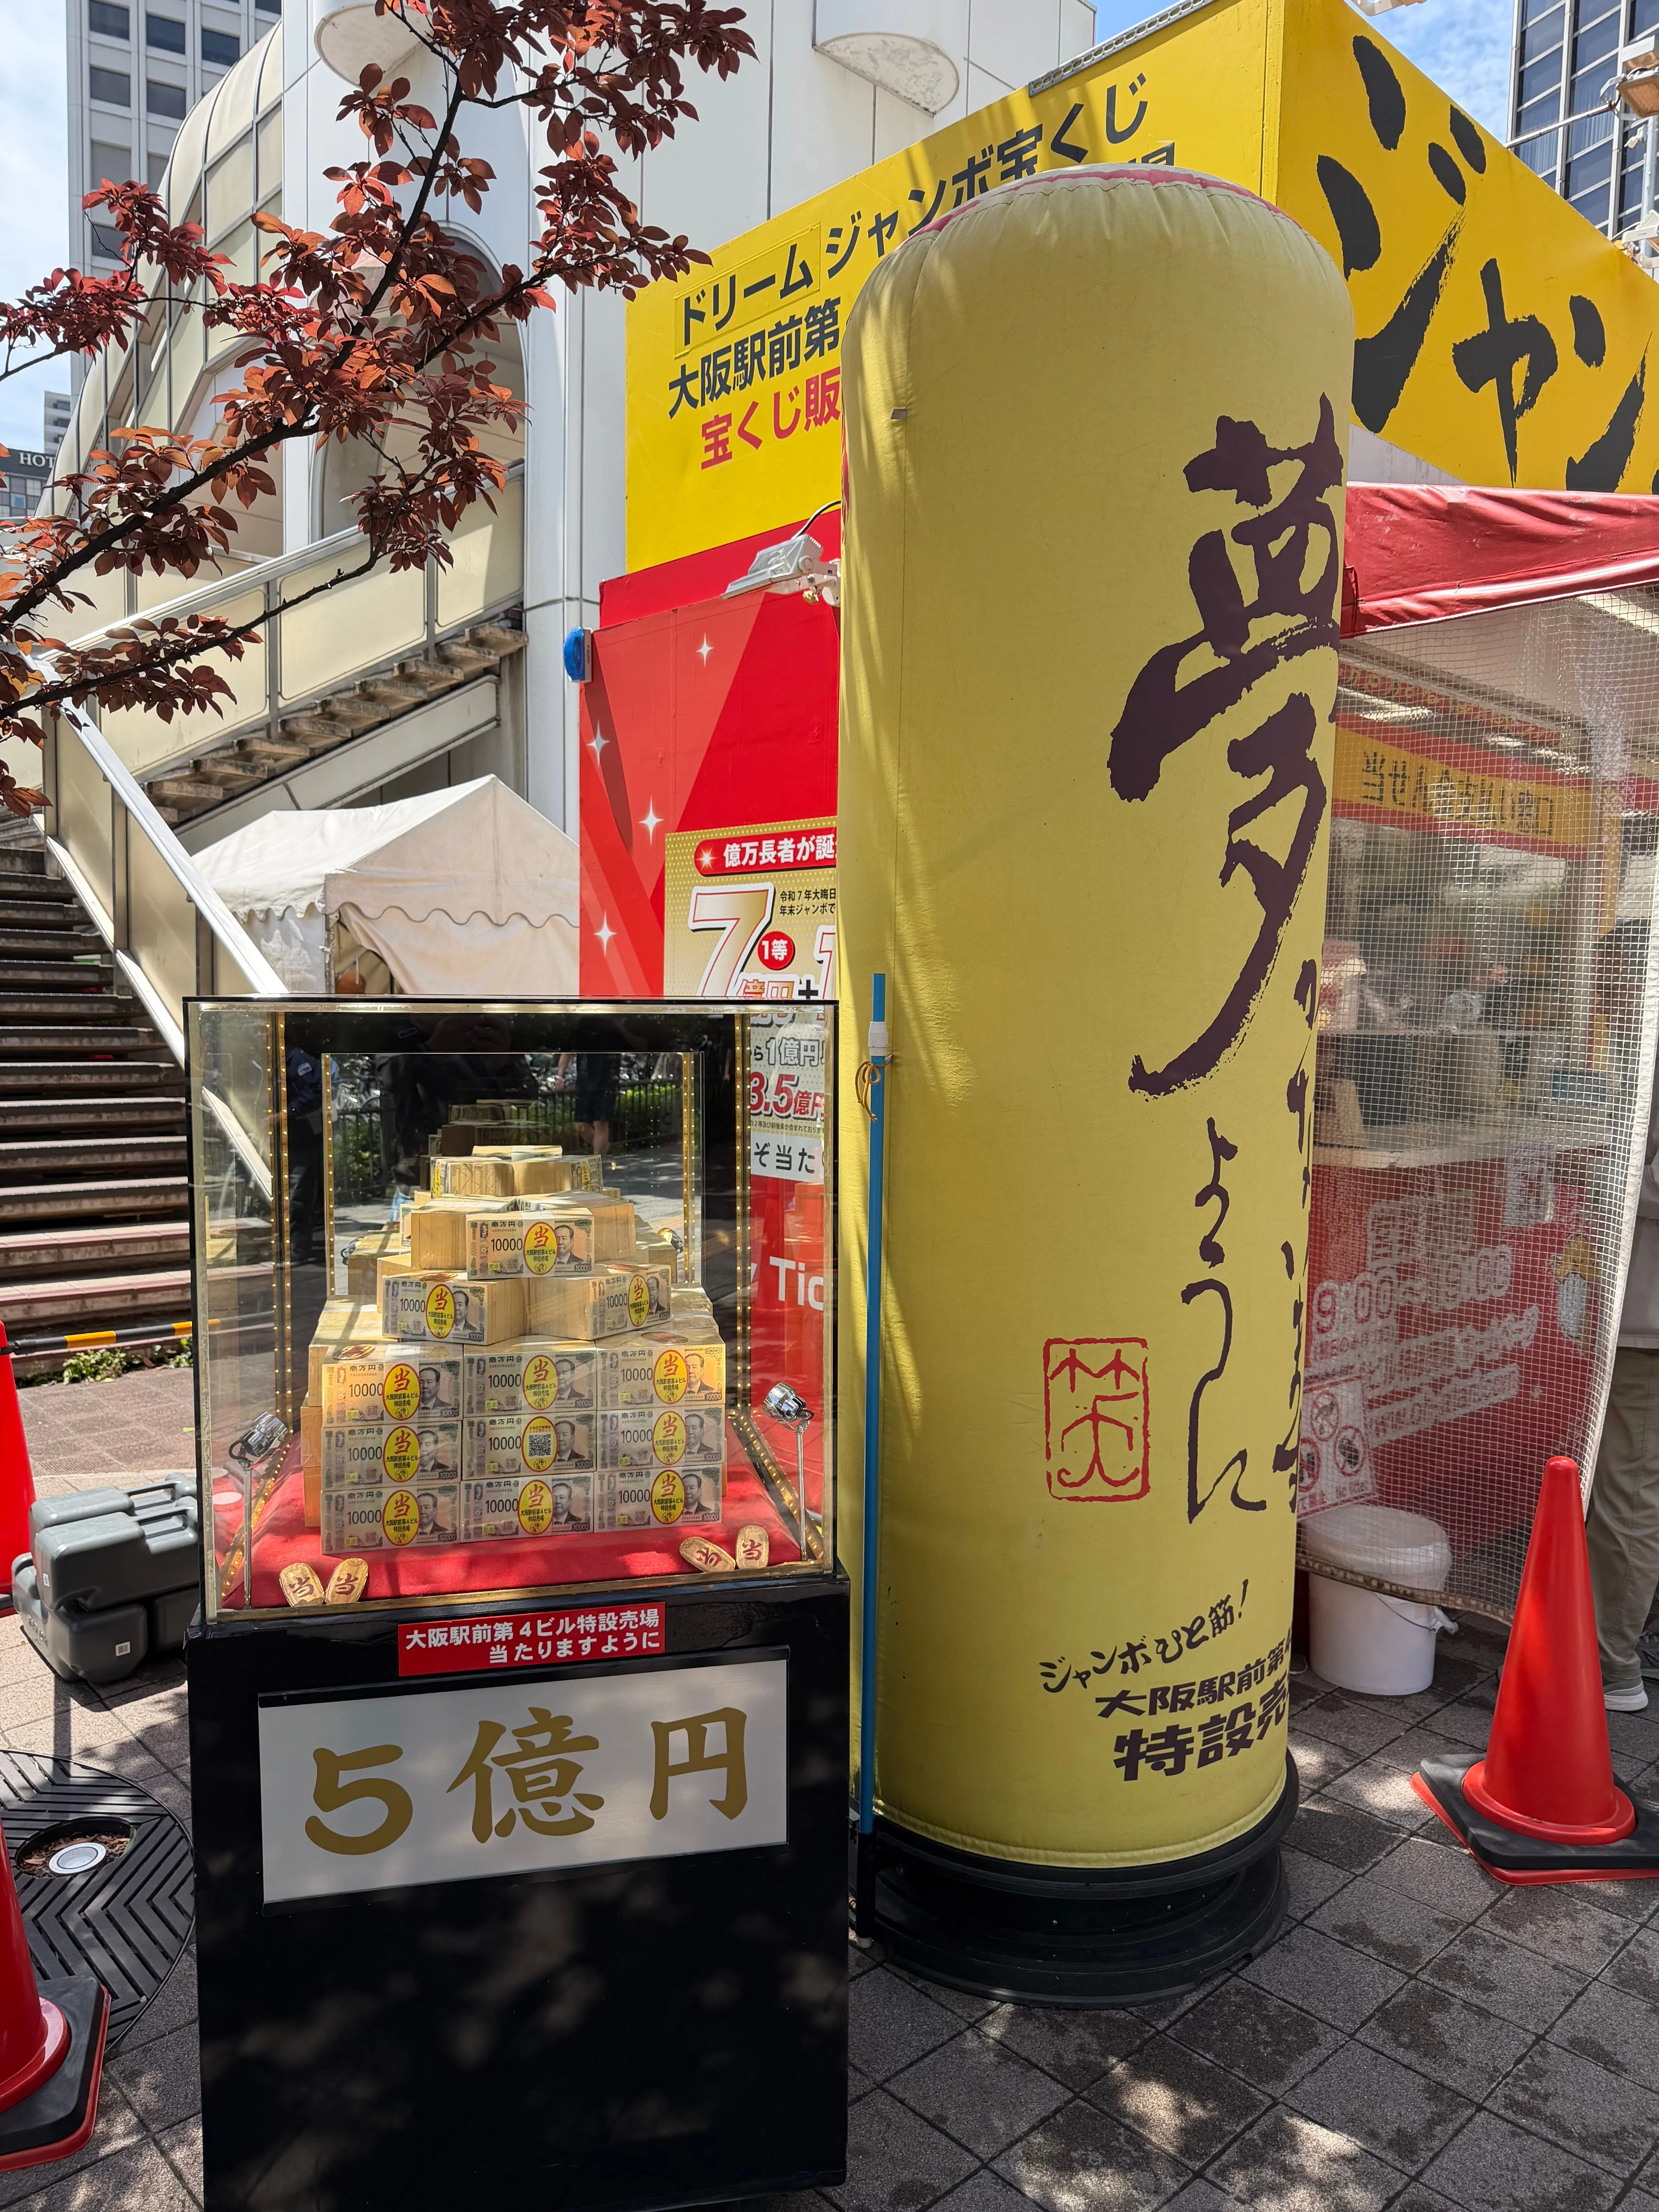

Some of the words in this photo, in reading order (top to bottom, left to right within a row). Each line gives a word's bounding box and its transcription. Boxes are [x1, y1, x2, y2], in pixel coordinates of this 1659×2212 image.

[1317, 35, 1659, 495] ジャン
[668, 296, 841, 419] 大阪駅前第
[701, 366, 841, 471] 宝くじ販
[723, 833, 837, 868] 億万長者が誕
[761, 939, 788, 961] 1等
[754, 1142, 824, 1174] ぞ当た
[491, 1238, 523, 1251] 10000
[534, 1226, 549, 1248] 当
[435, 1288, 448, 1310] 当
[606, 1293, 627, 1309] 10000
[634, 1279, 644, 1301] 当
[400, 1299, 425, 1312] 10000
[534, 1359, 549, 1382] 当
[621, 1368, 653, 1382] 10000
[664, 1354, 678, 1377] 当
[394, 1368, 410, 1392] 当
[488, 1374, 521, 1388] 10000
[621, 1429, 653, 1443] 10000
[663, 1415, 677, 1438] 当
[395, 1430, 411, 1454] 当
[488, 1436, 521, 1450] 10000
[348, 1446, 382, 1461] 10000
[528, 1484, 544, 1508] 当
[618, 1489, 650, 1503] 10000
[661, 1474, 676, 1497] 当
[394, 1494, 410, 1518] 当
[347, 1510, 381, 1525] 10000
[696, 1547, 722, 1567] 当
[742, 1539, 762, 1561] 当
[289, 1577, 314, 1597] 当
[335, 1573, 359, 1595] 当
[406, 1609, 659, 1650] 大阪駅前第4ビル特設売場
[489, 1632, 659, 1664] 当たりますように
[1113, 1668, 1290, 1782] 特設売
[304, 1706, 748, 1856] 5億円
